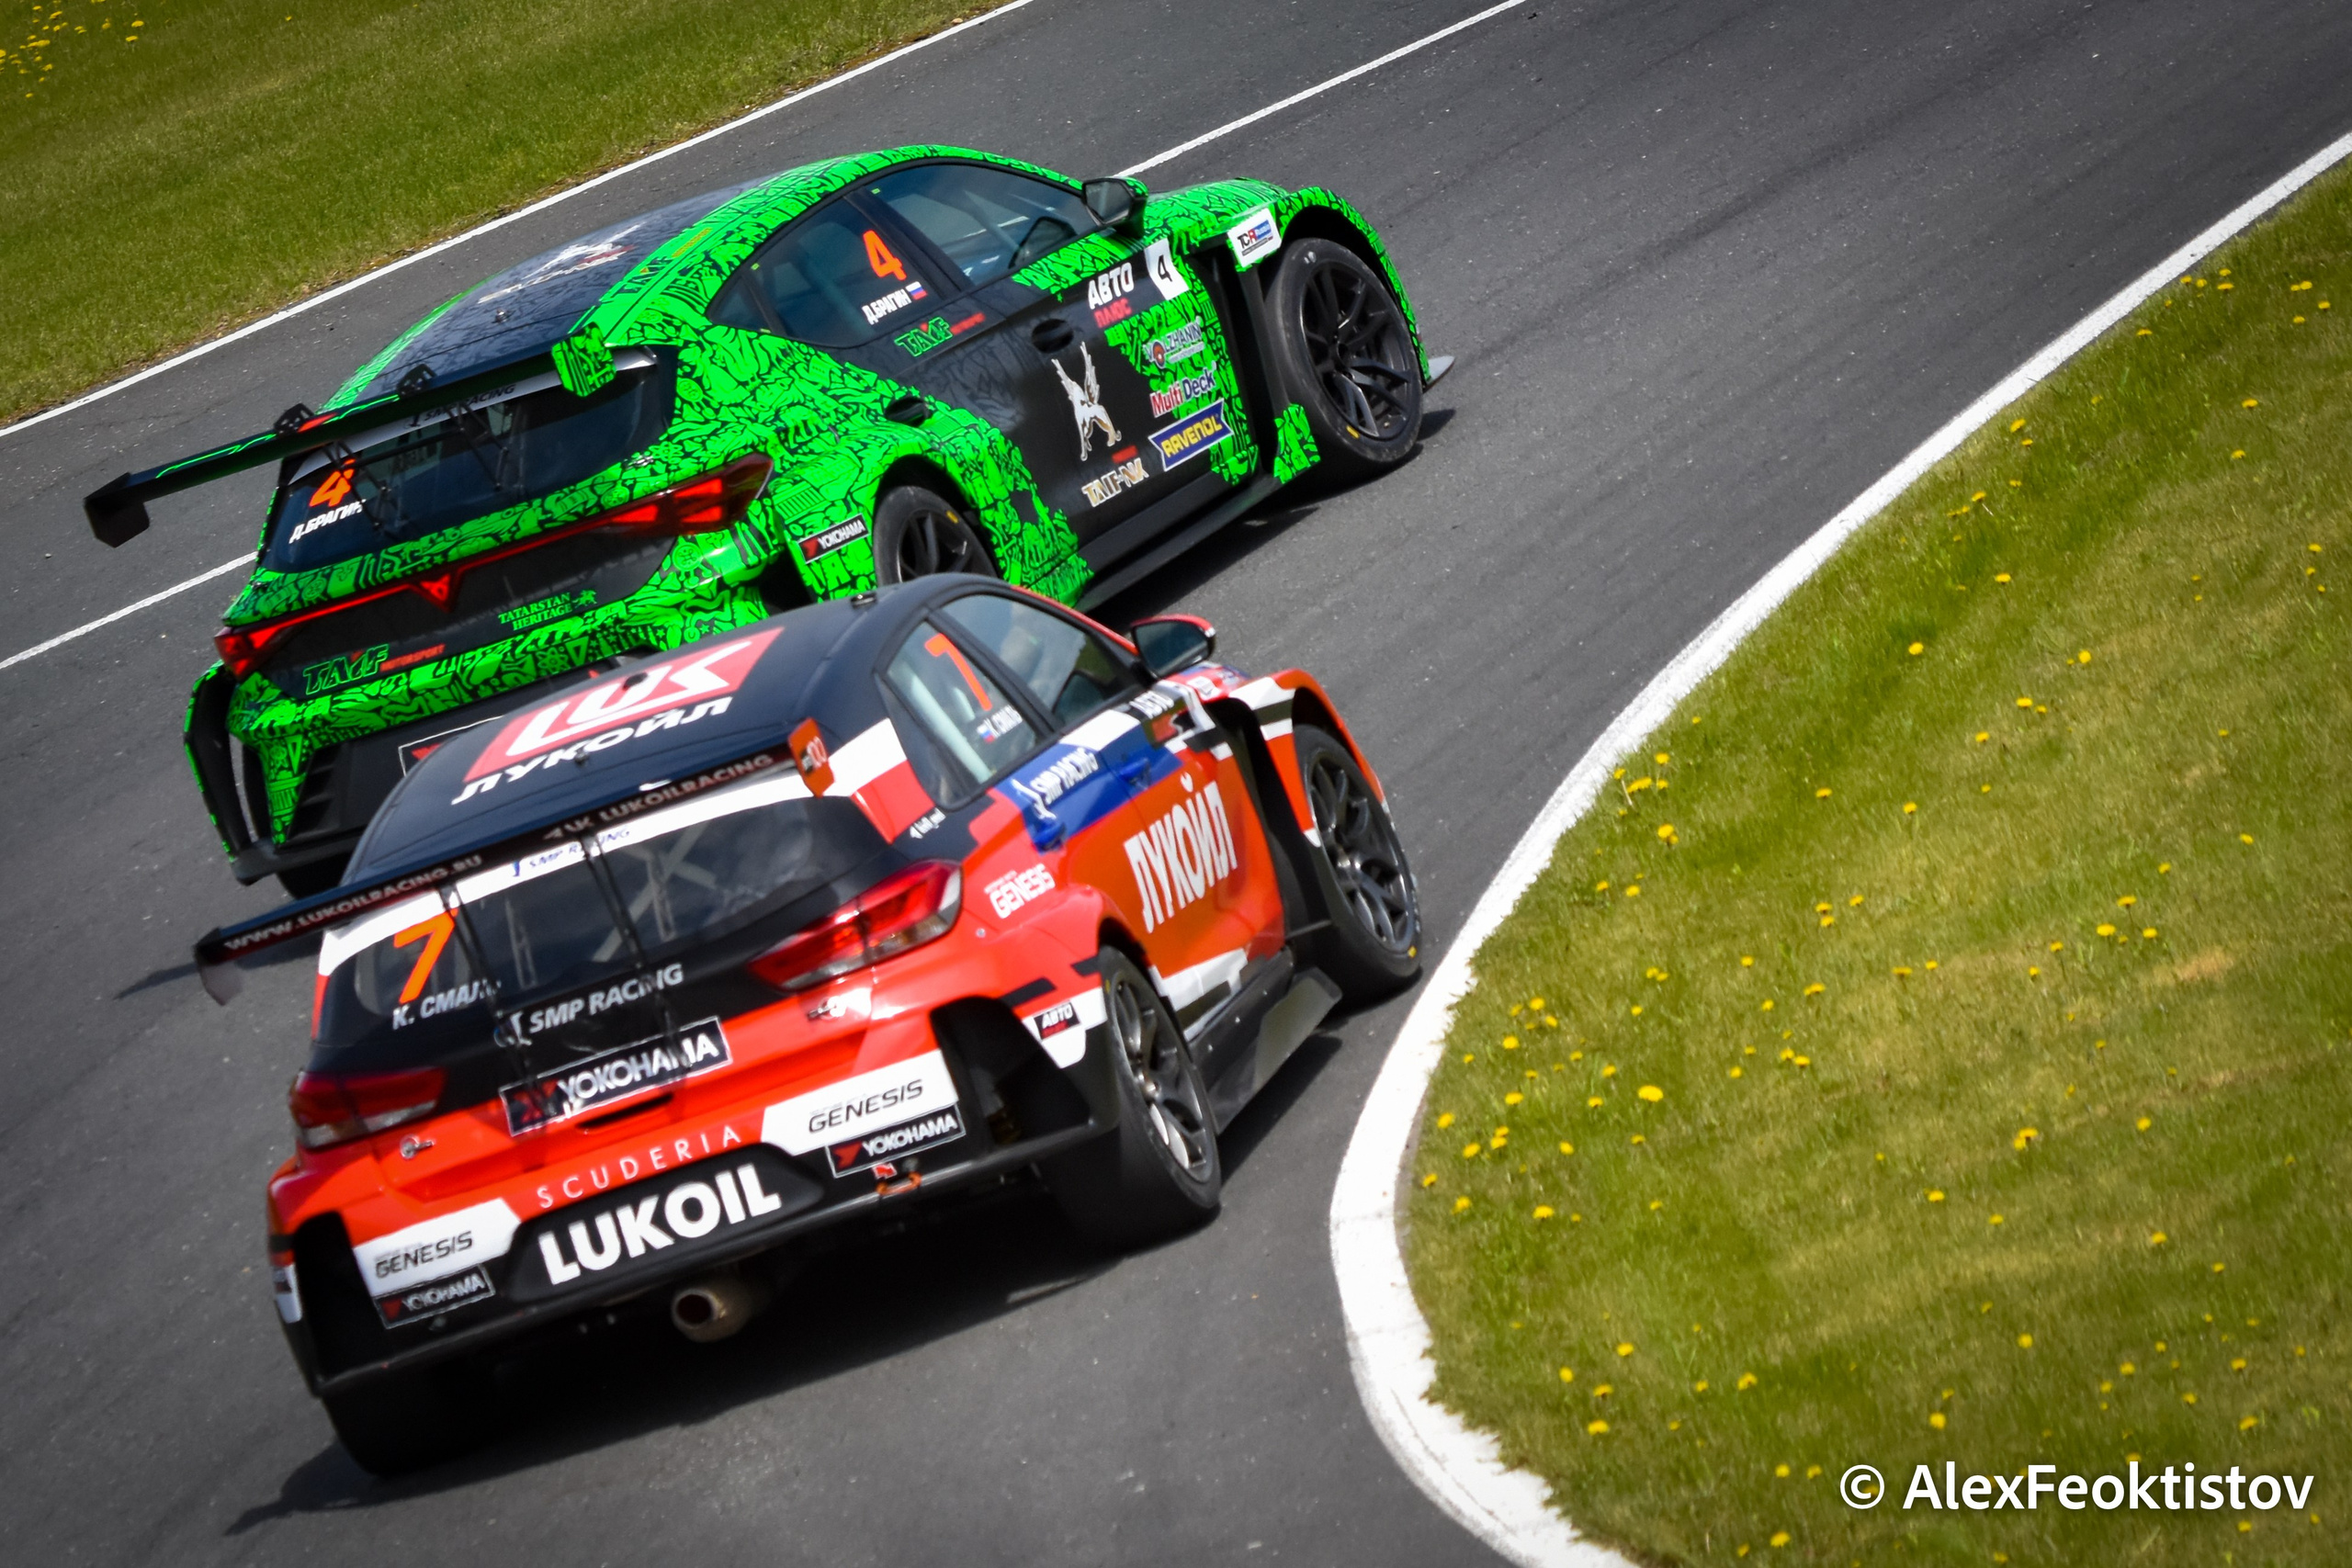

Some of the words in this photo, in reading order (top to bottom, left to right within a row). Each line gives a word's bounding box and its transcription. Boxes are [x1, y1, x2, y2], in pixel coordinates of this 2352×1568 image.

[863, 230, 907, 281] 4
[1238, 229, 1258, 249] TCR
[1157, 254, 1173, 283] 4
[862, 288, 911, 325] Д.БРАГИН
[1160, 414, 1223, 457] RAVENOL
[309, 458, 356, 507] 4
[817, 519, 865, 549] YOKOHAMA
[499, 592, 571, 625] TATARSTAN
[513, 603, 573, 630] HERITAGE
[924, 633, 992, 711] 7
[451, 696, 733, 805] ЛУКОЙЛ
[599, 753, 775, 822] LUKOILRACING
[1124, 772, 1238, 934] ЛУКОЙЛ
[224, 854, 482, 951] WWW.LUKOILRACING.RU
[989, 863, 1056, 919] GENESIS
[392, 907, 458, 1004] 7
[528, 999, 585, 1033] SMP
[557, 1032, 719, 1105] YOKOHAMA
[808, 1078, 924, 1135] GENESIS
[861, 1114, 958, 1157] YOKOHAMA
[536, 1124, 741, 1209] SCUDERIA
[537, 1163, 783, 1285] LUKOIL
[375, 1229, 473, 1279] GENESIS
[400, 1272, 486, 1313] YOKOHAMA
